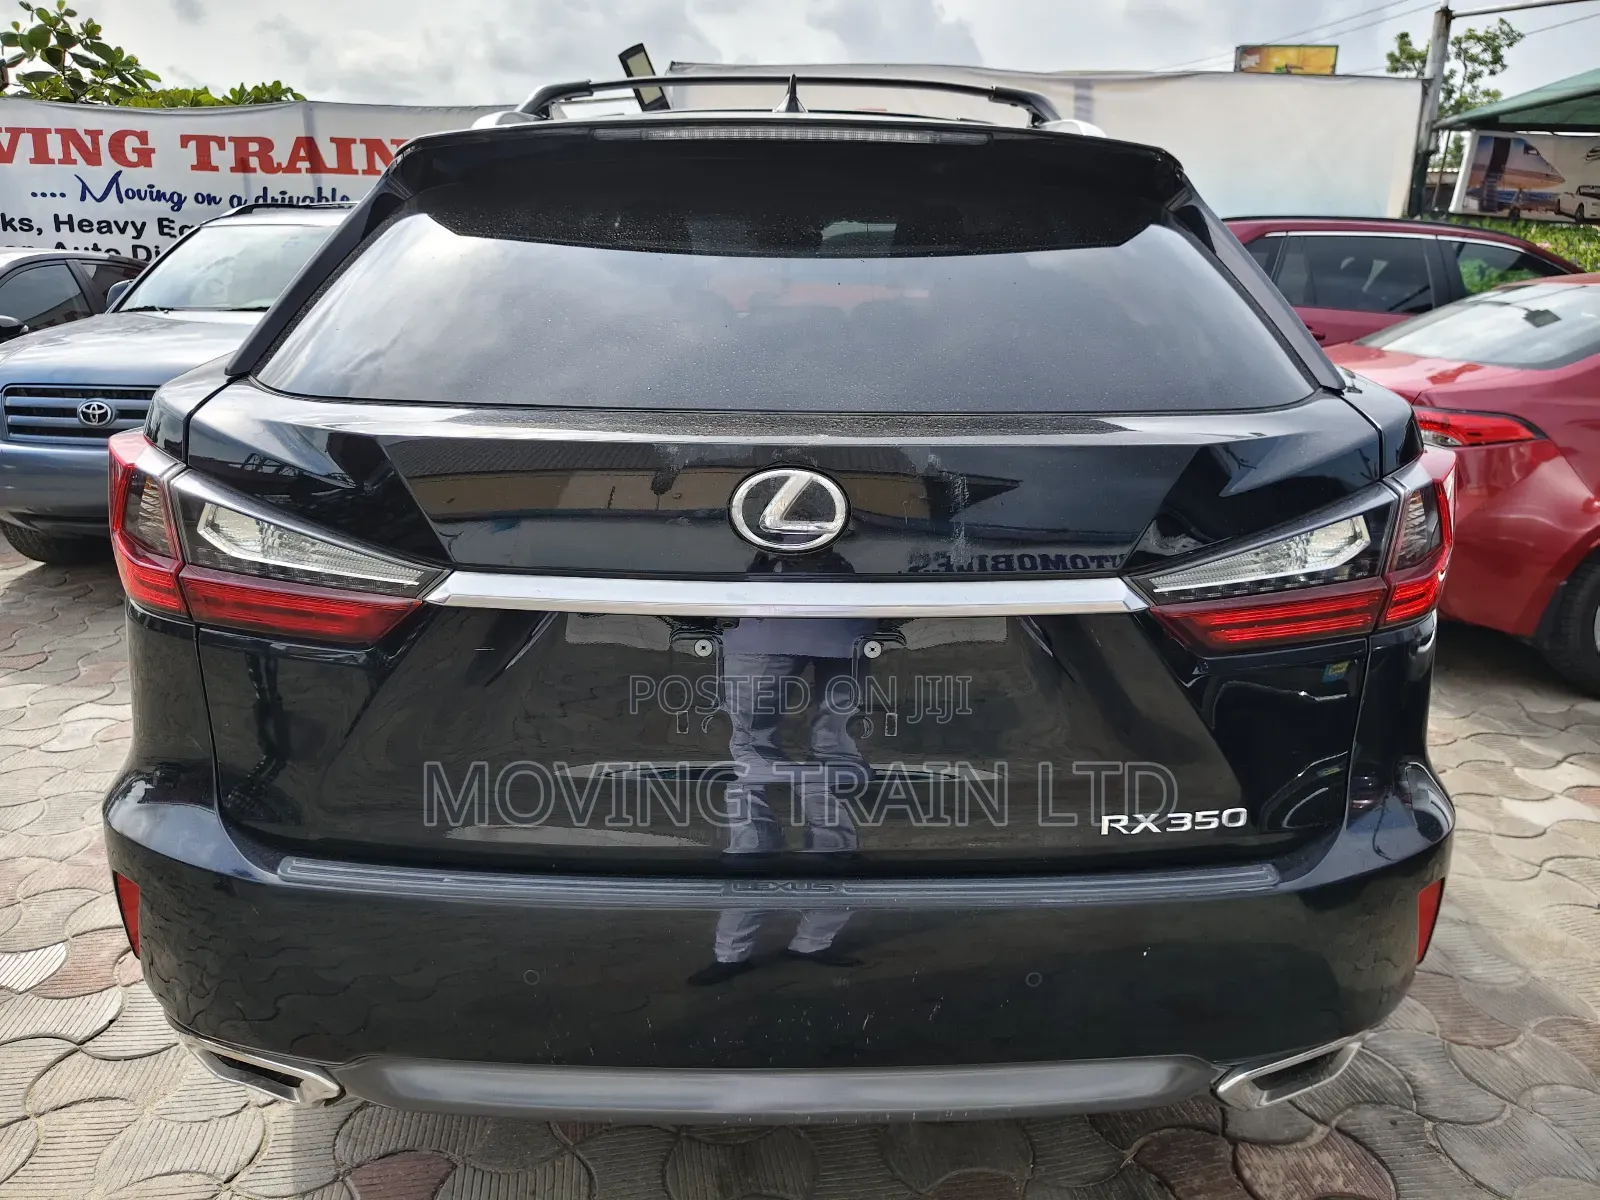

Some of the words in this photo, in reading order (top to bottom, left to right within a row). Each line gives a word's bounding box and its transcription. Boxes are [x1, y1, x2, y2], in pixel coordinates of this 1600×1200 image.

[74, 170, 187, 212] Moving
[194, 191, 222, 206] on
[229, 194, 248, 208] a
[0, 213, 43, 236] ks,
[53, 213, 147, 240] Heavy
[731, 881, 835, 893] LEXUS
